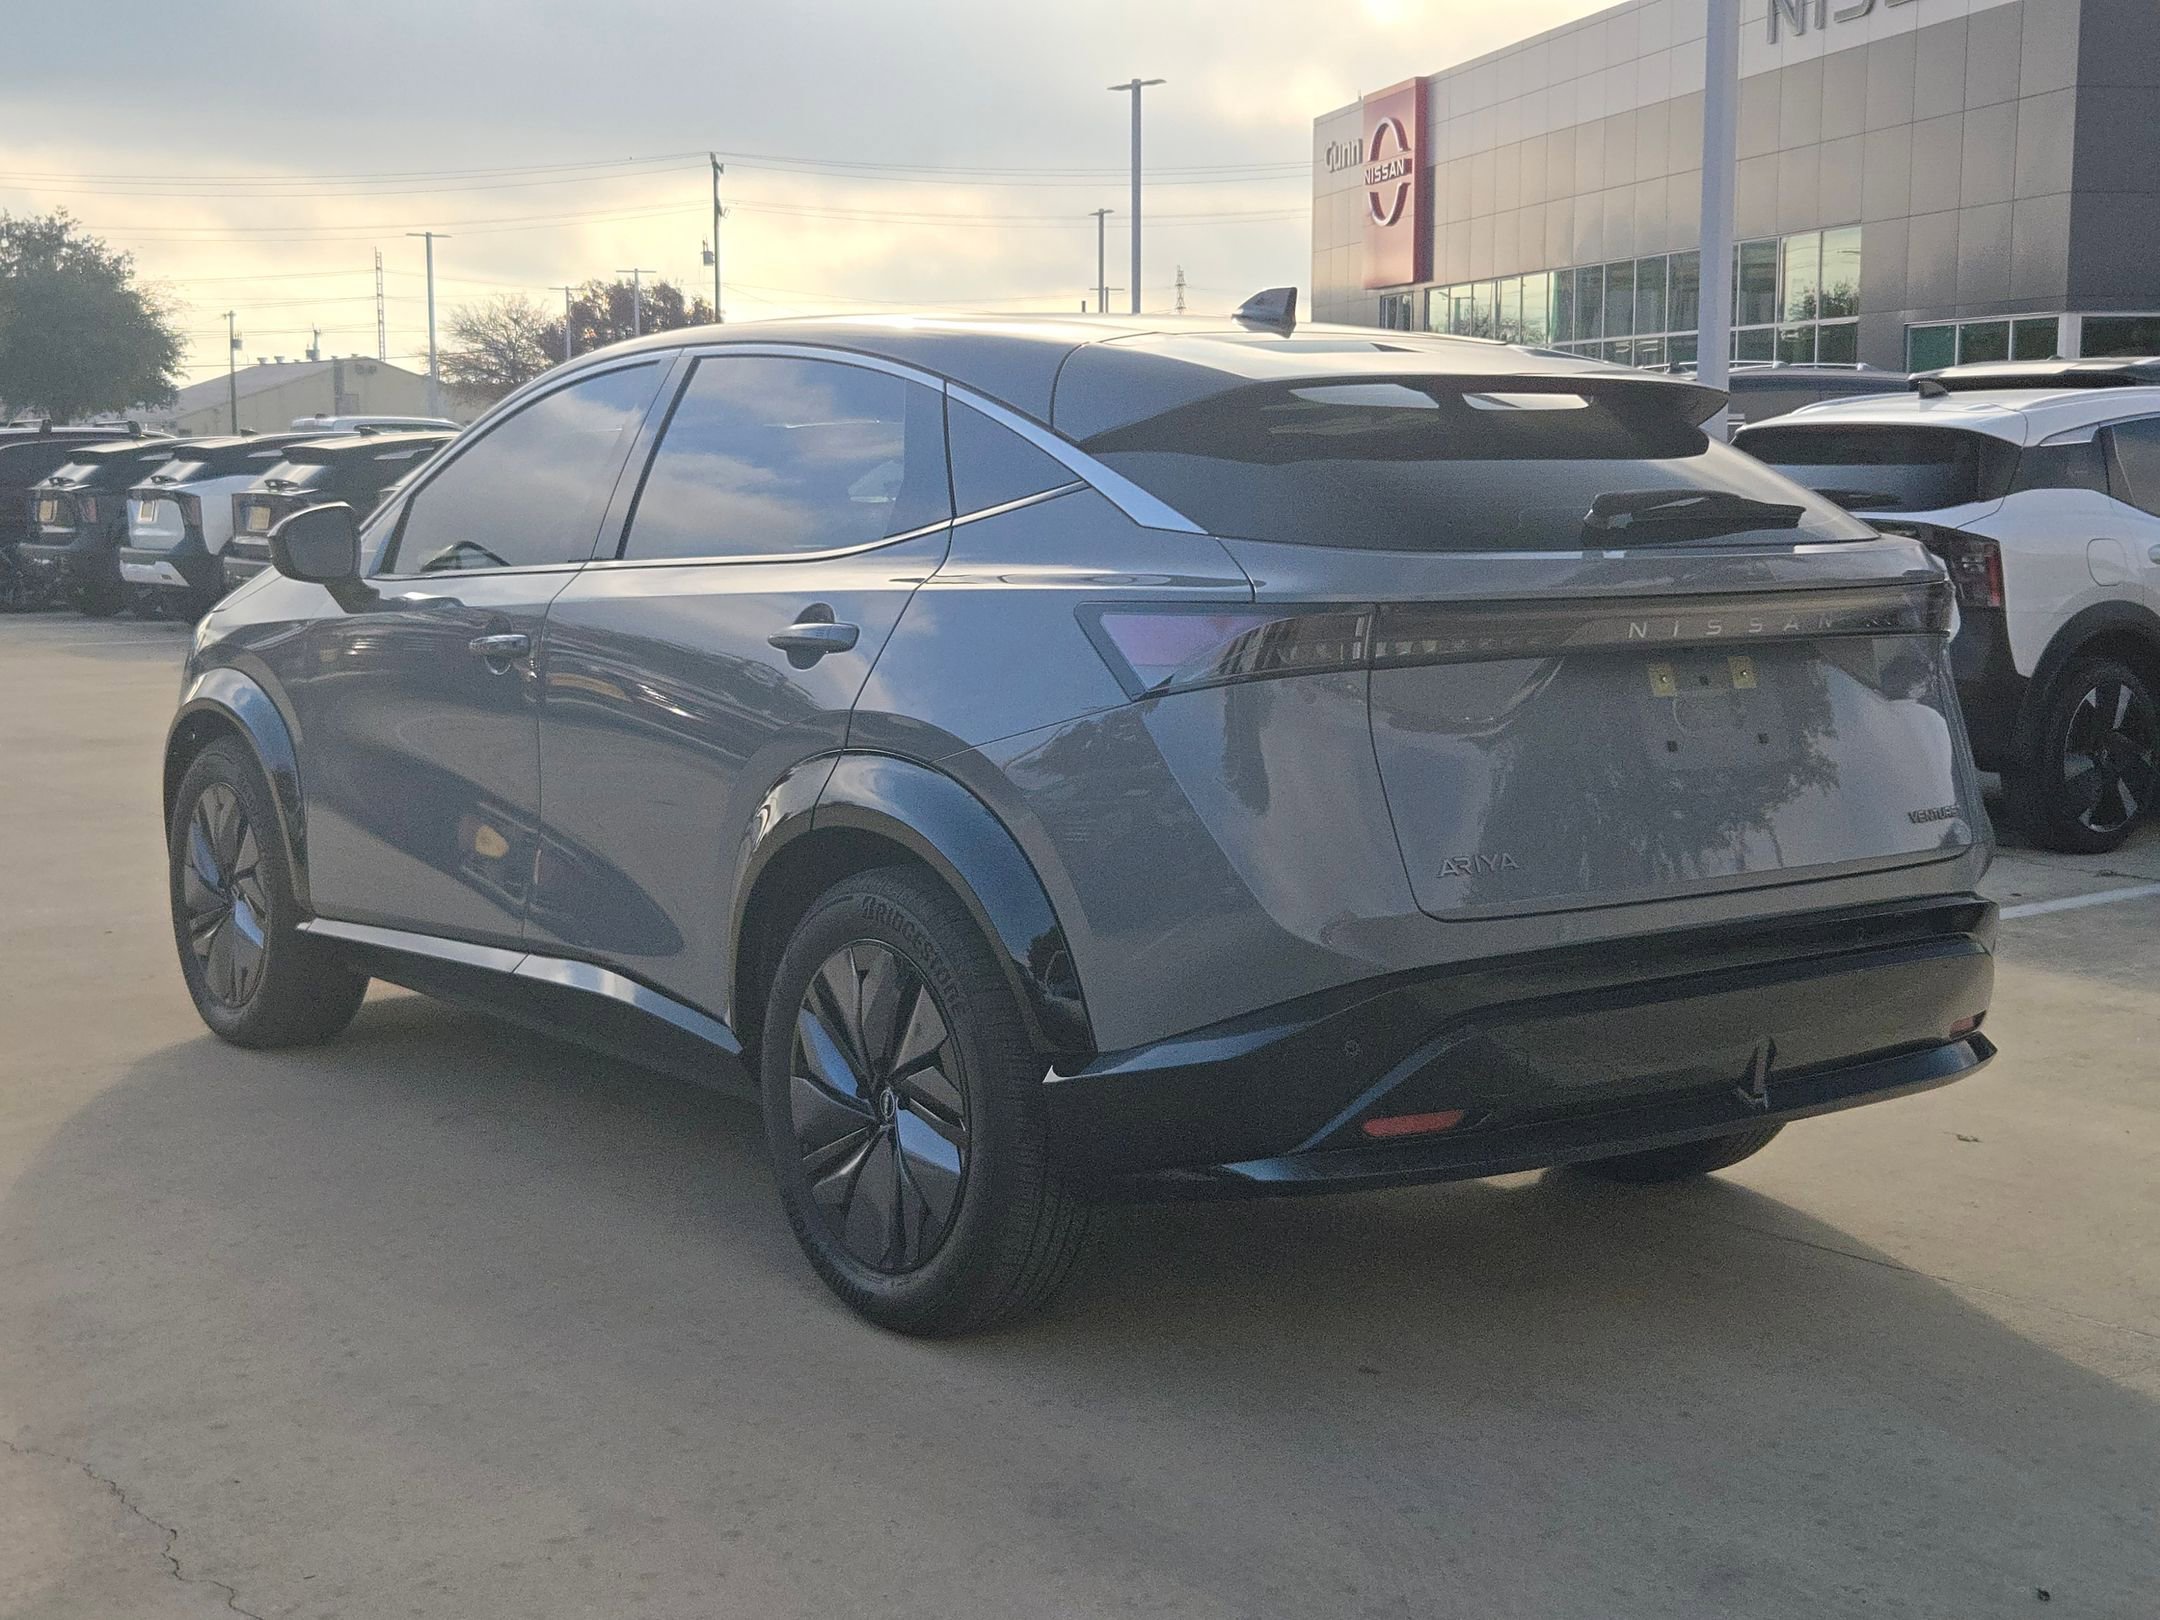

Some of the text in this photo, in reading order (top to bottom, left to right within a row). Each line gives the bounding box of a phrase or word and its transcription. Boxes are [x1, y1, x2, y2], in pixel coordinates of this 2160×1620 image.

[1364, 159, 1406, 185] NISSAN
[1628, 617, 1833, 640] NISSAN
[1436, 852, 1521, 878] ARIYA
